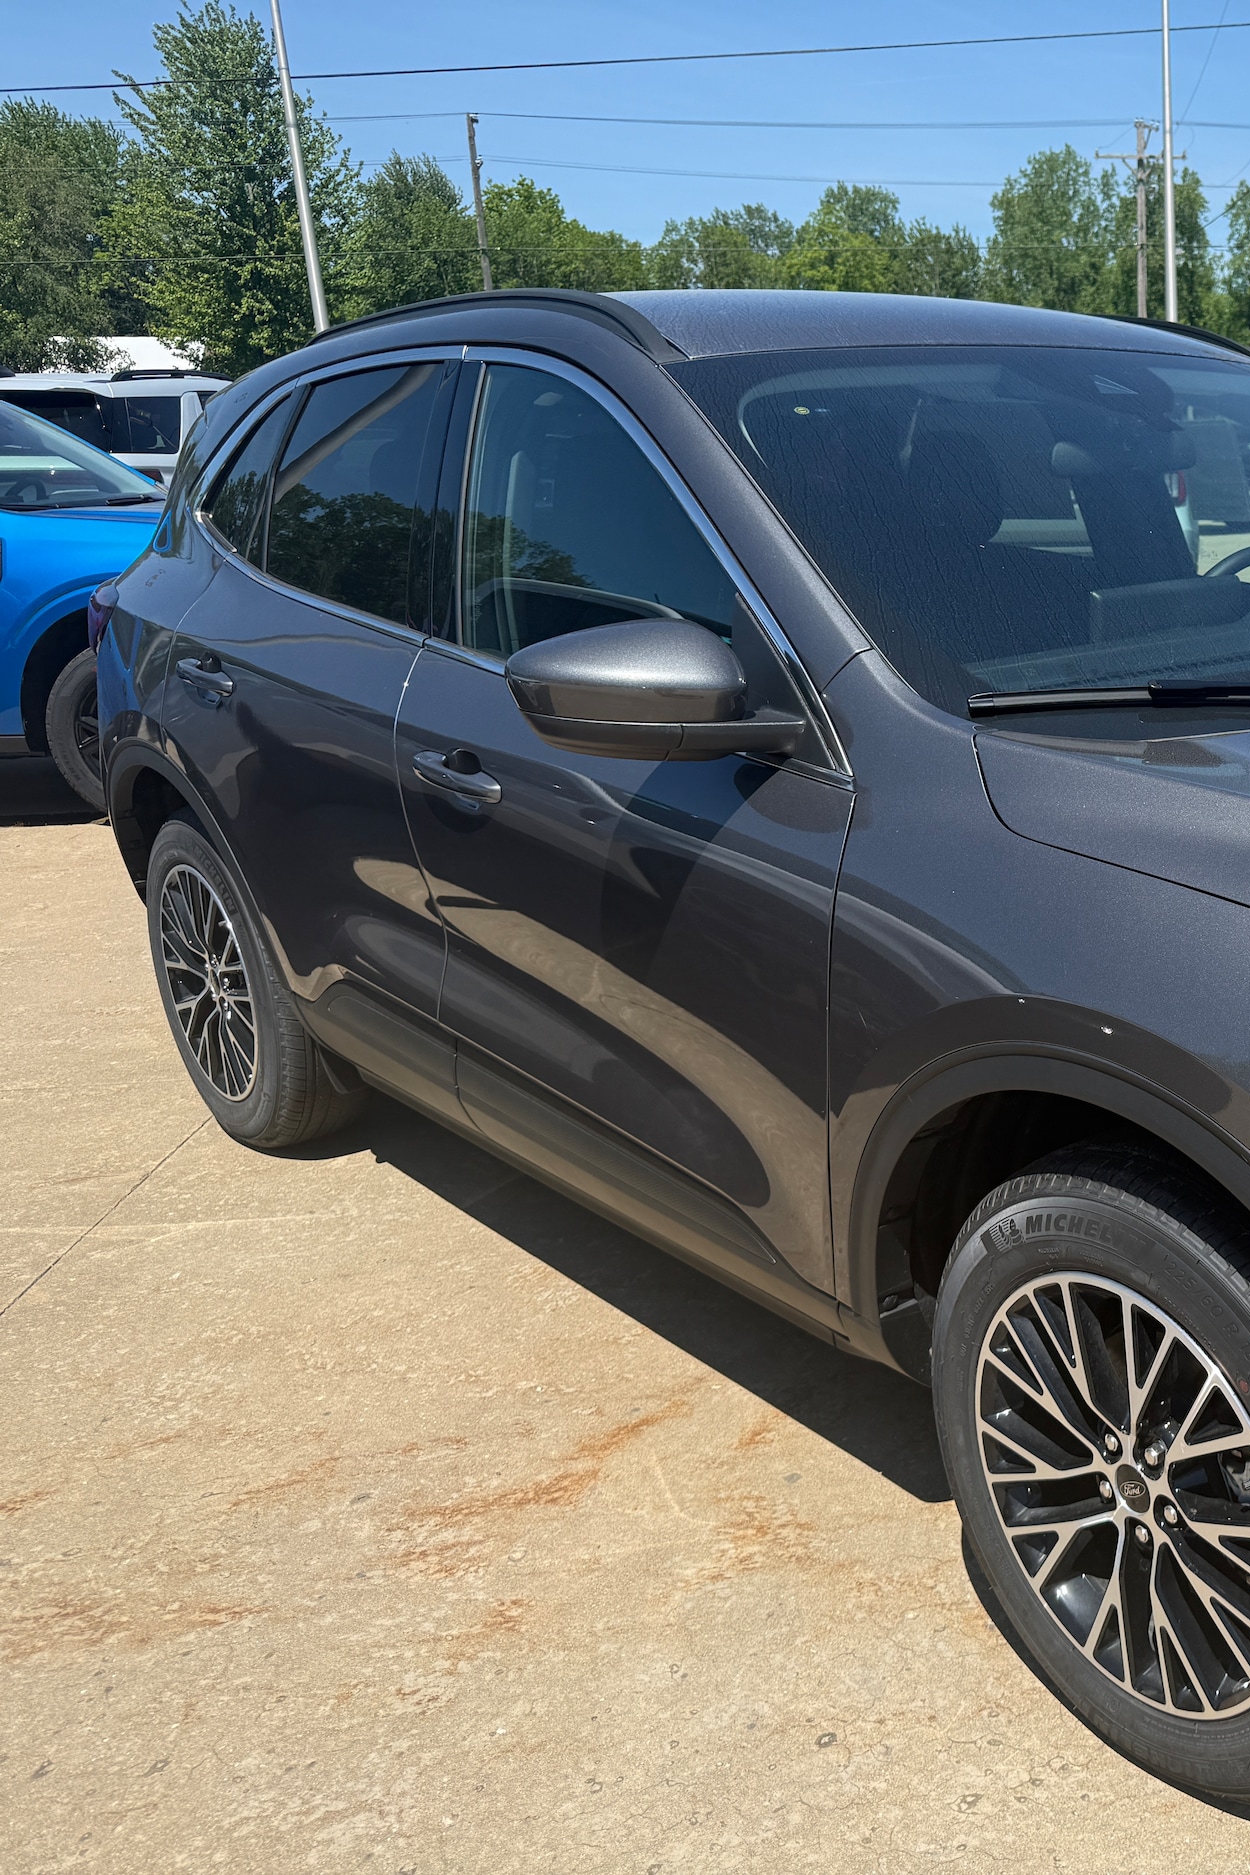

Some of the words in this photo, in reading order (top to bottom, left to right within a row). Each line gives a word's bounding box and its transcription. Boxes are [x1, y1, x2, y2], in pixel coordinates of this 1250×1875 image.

[192, 844, 236, 912] MICHELIN
[1025, 1213, 1146, 1249] MICHEL
[1222, 1321, 1239, 1338] R
[1124, 1483, 1140, 1496] Ford
